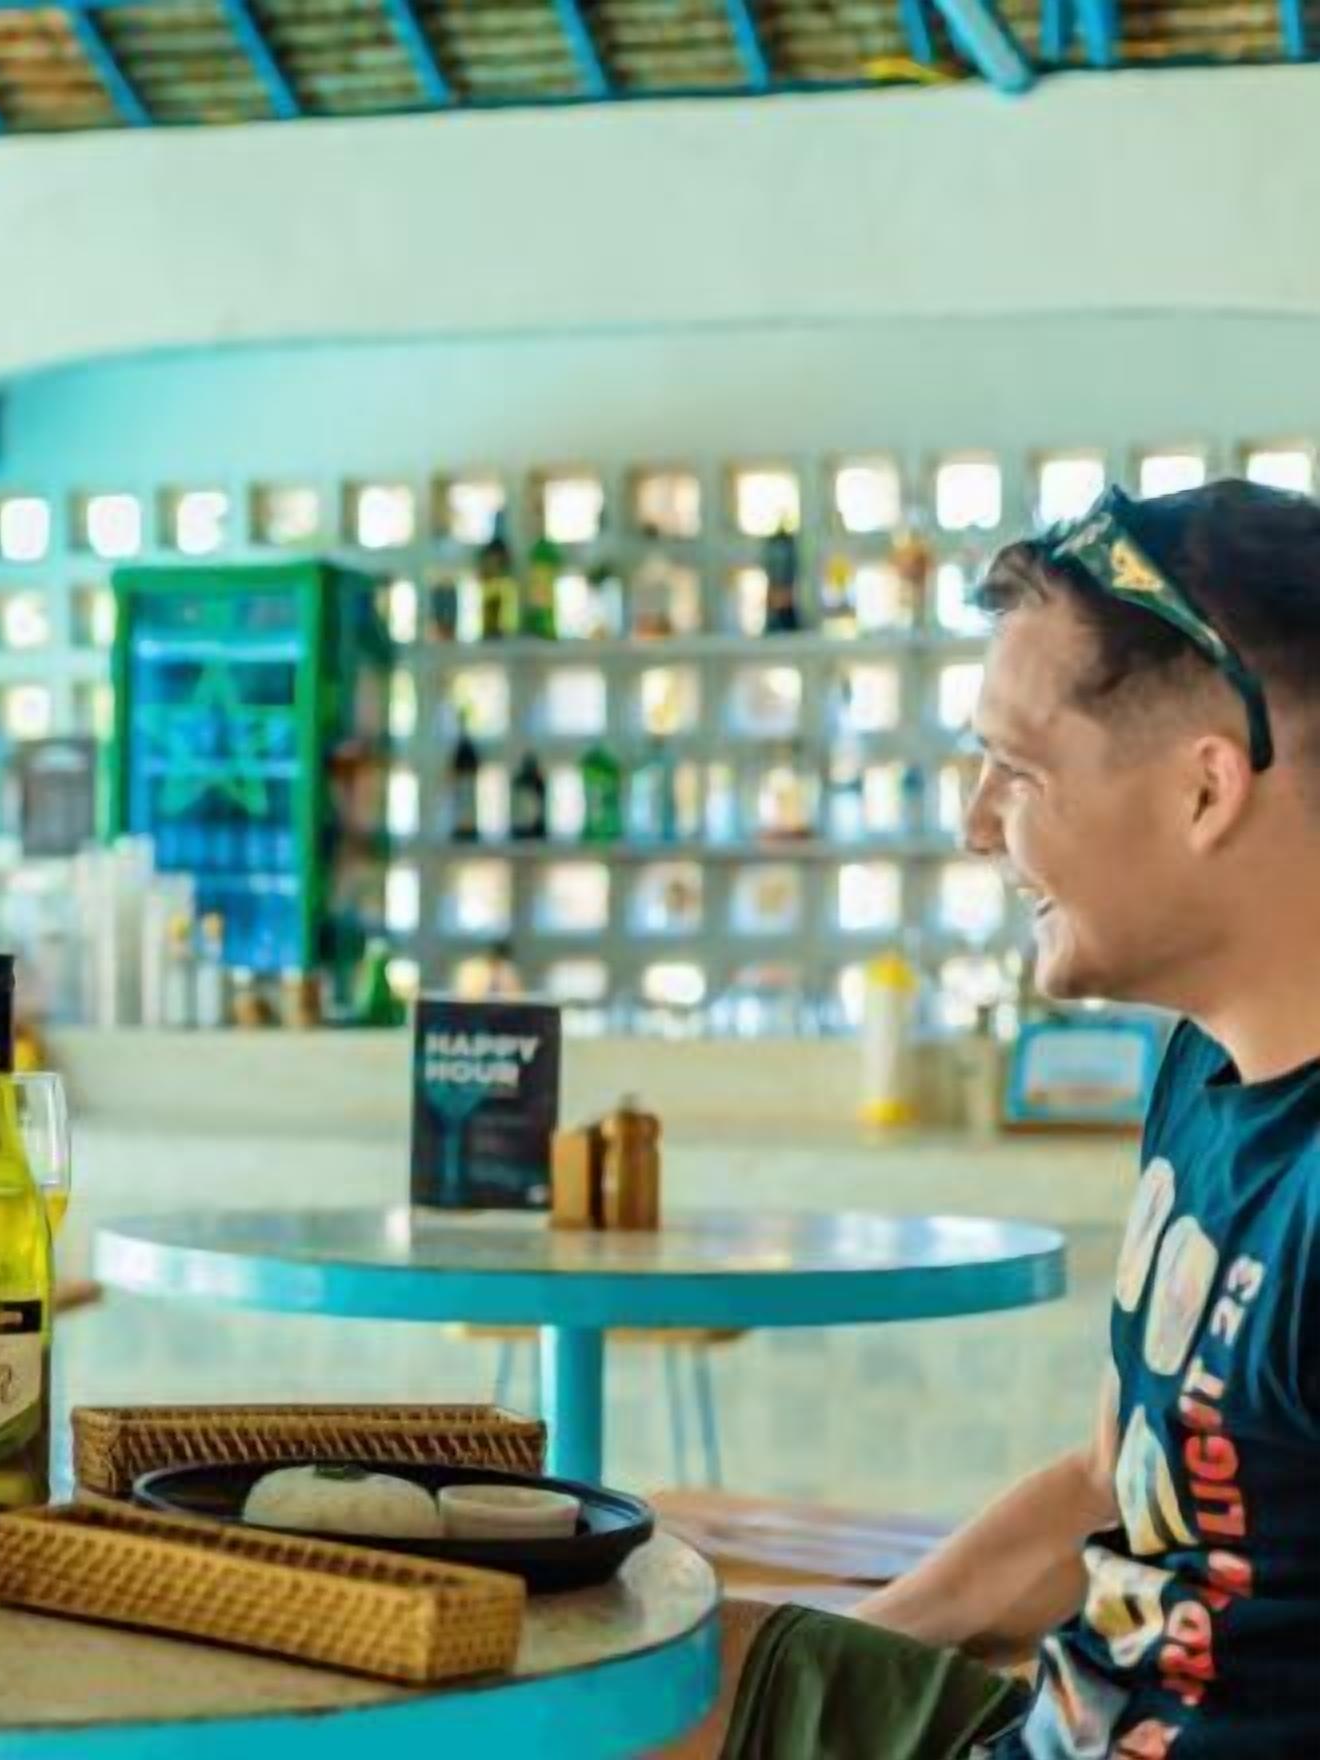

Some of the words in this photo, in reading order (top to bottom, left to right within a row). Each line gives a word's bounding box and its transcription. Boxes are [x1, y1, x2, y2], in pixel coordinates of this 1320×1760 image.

[424, 1032, 539, 1062] HAPPY
[424, 1060, 520, 1087] HOUR
[1209, 1254, 1265, 1346] 23
